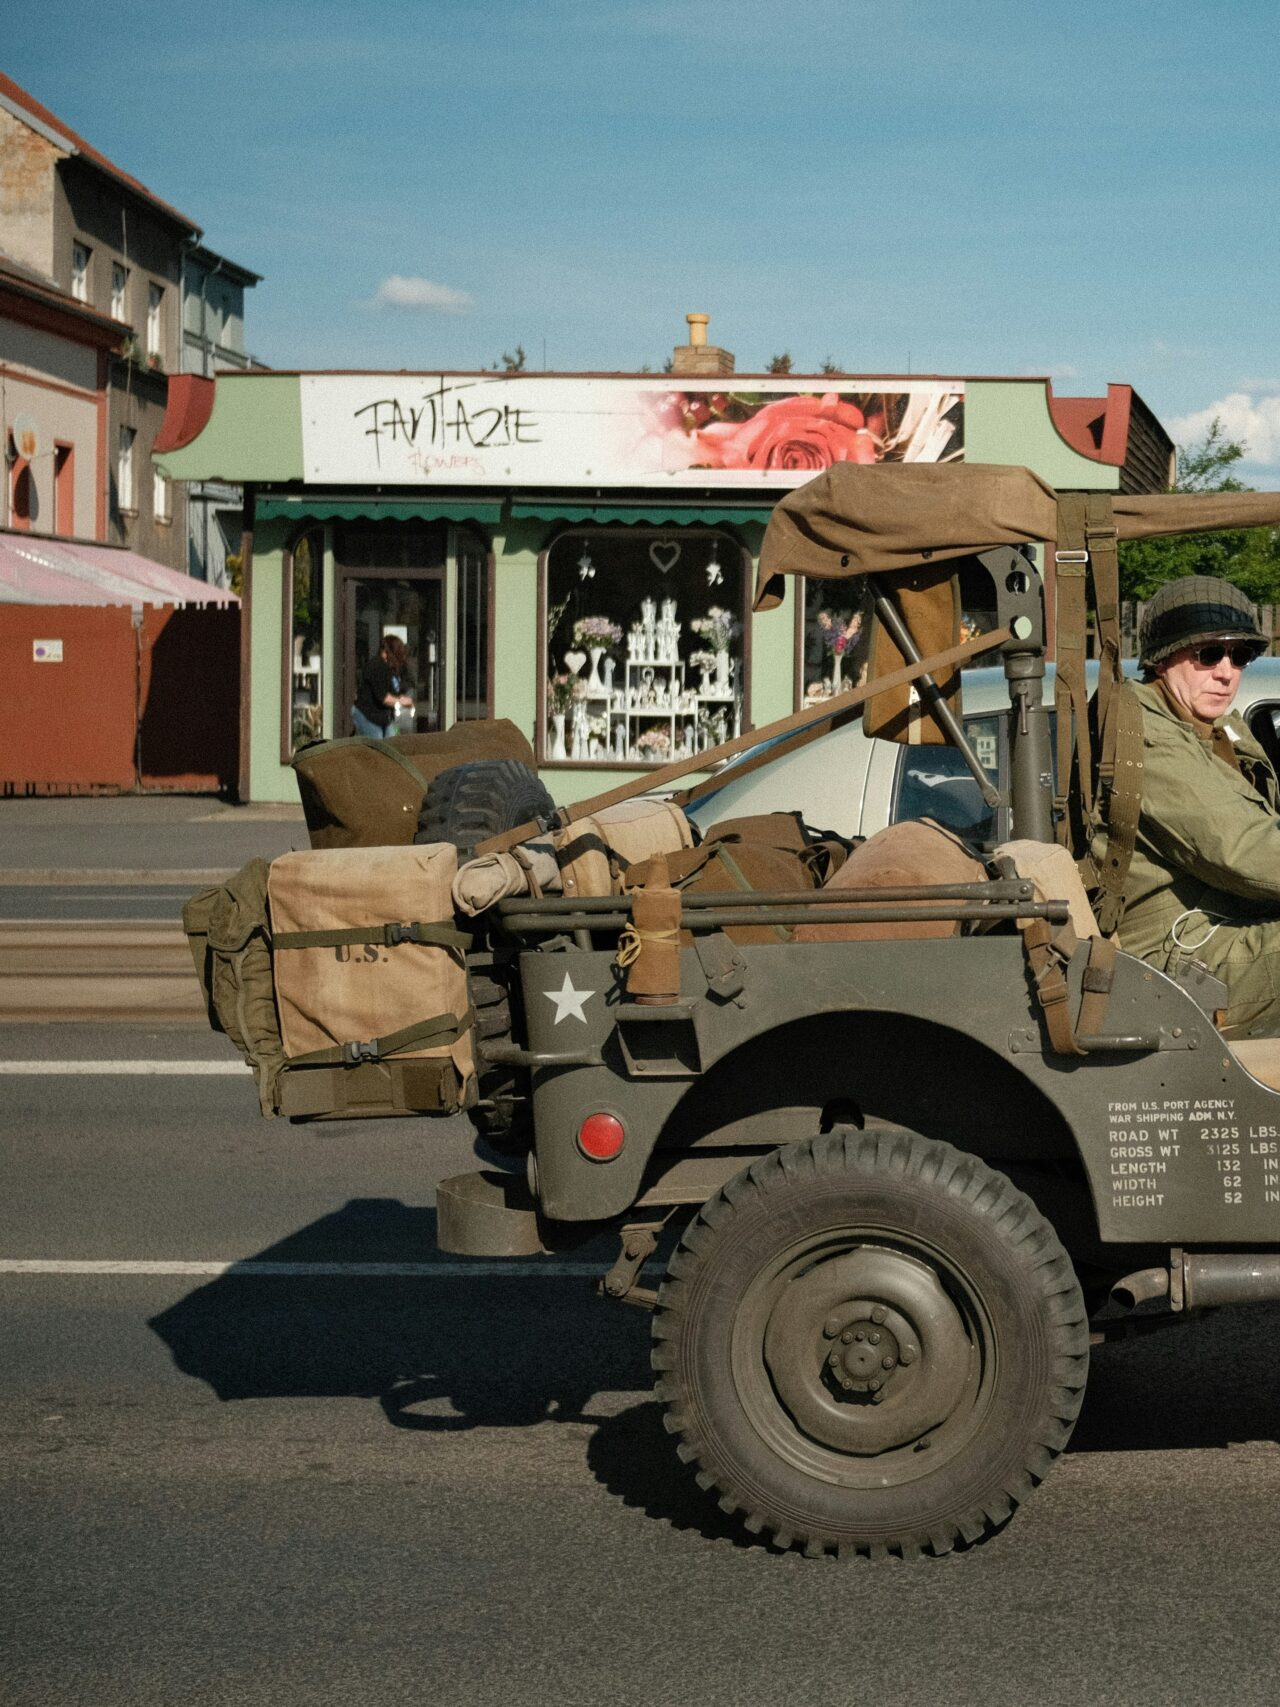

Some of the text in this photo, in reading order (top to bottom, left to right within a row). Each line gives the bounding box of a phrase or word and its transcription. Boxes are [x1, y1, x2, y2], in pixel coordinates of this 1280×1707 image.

[1108, 1100, 1235, 1112] FROM U.S. PORT AGENCY
[1109, 1111, 1237, 1123] WAR SHIPPING ADM. N.Y.
[1109, 1126, 1280, 1142] ROAD WT 2325 LBS.
[1110, 1142, 1278, 1158] GROSS WT 3125 LBS
[1110, 1158, 1279, 1175] LENGTH 132 IN
[1112, 1174, 1279, 1191] WIDTH 62 IN
[1112, 1194, 1164, 1207] HEIGHT
[1224, 1192, 1242, 1204] 52
